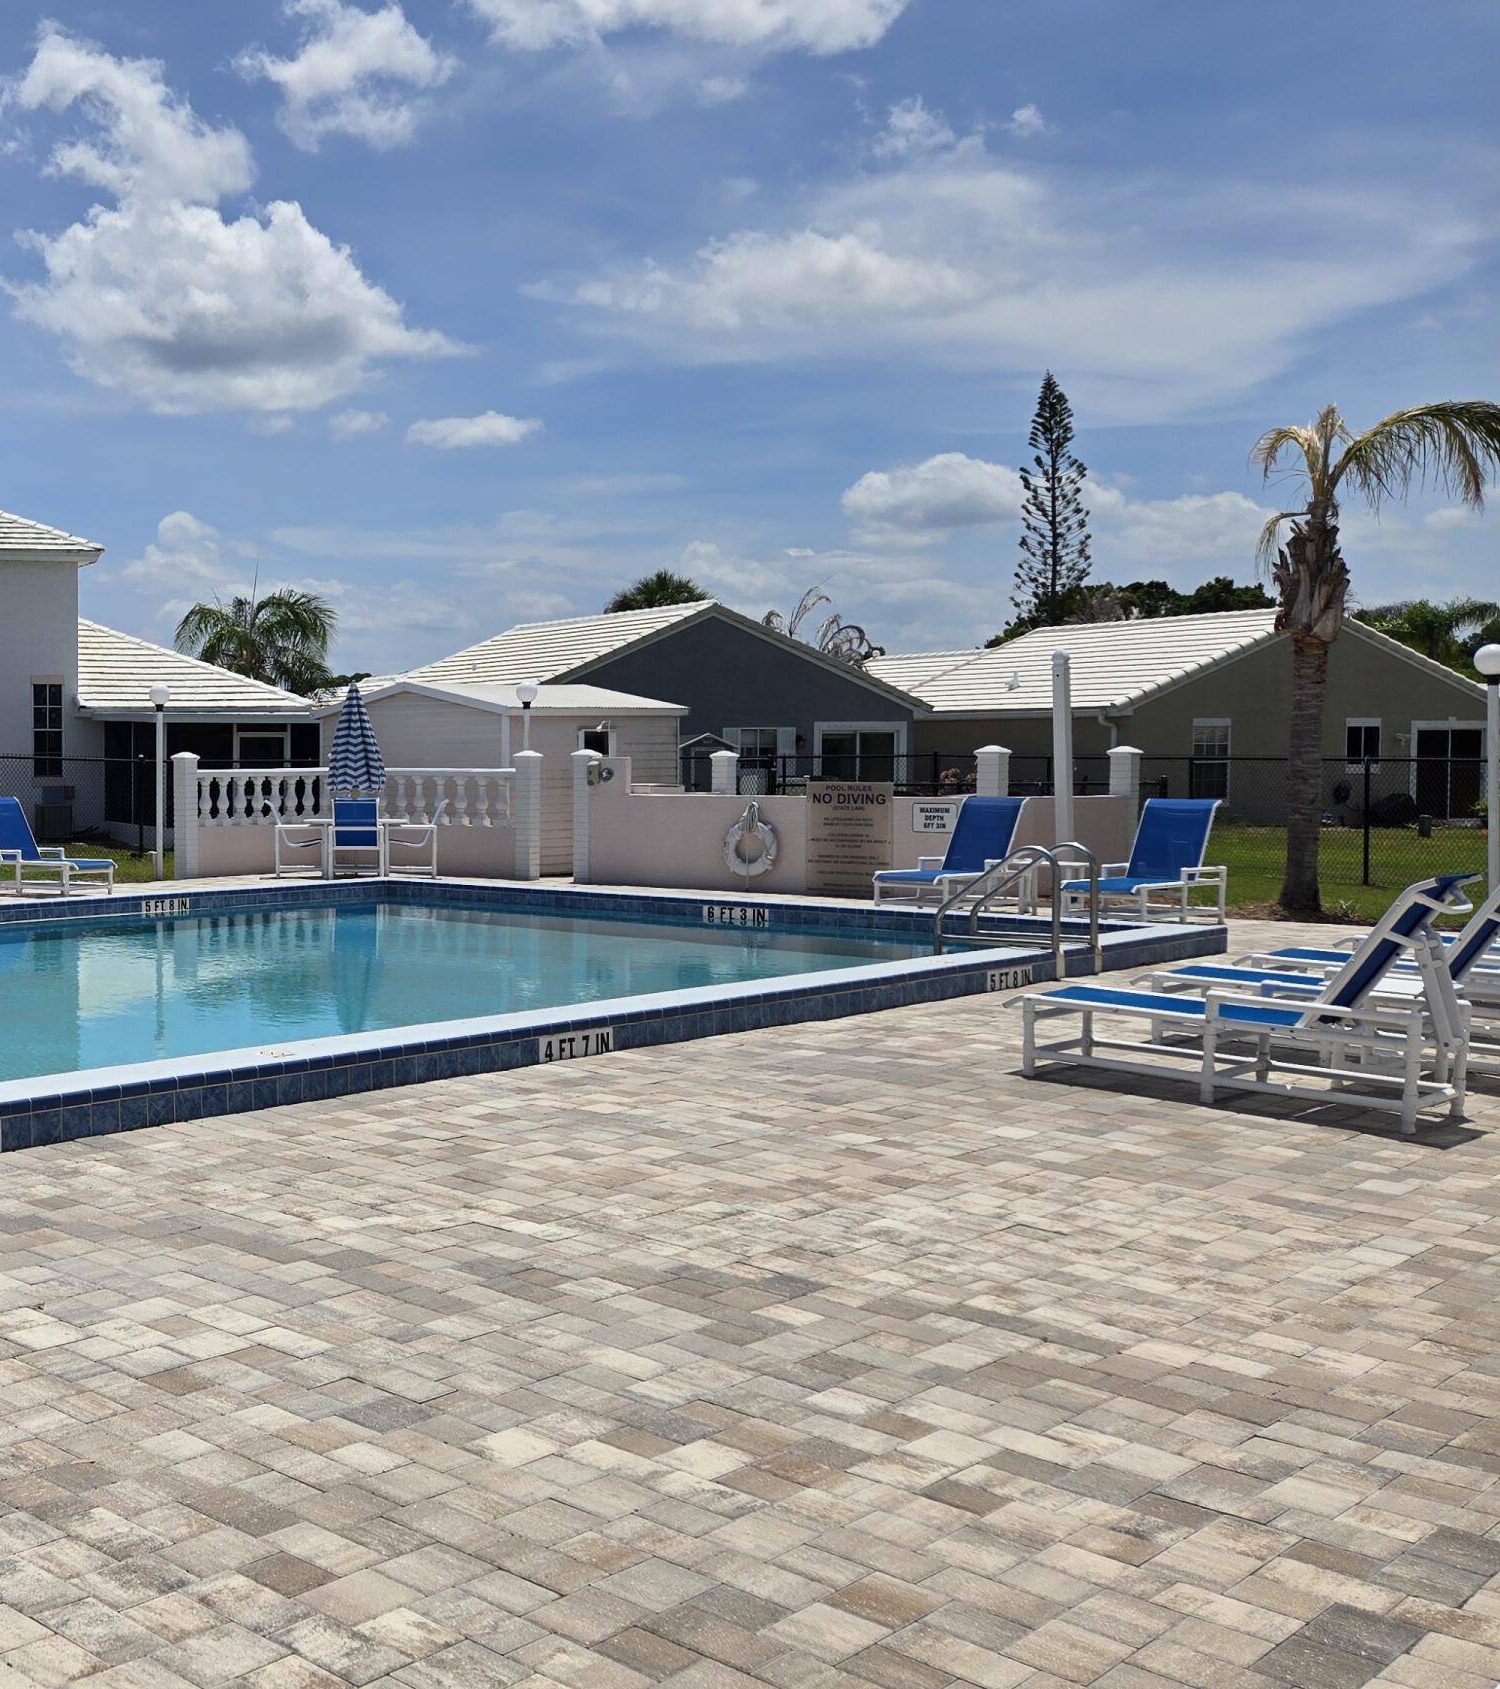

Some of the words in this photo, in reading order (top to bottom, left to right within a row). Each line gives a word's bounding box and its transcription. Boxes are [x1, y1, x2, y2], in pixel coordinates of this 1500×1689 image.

[813, 793, 832, 804] NO
[837, 793, 886, 805] DIVING
[145, 901, 151, 912] 5
[169, 899, 174, 911] 8
[707, 906, 715, 919] 6
[740, 908, 747, 921] 3
[990, 974, 996, 991] 5
[1013, 970, 1018, 988] 8
[545, 1041, 553, 1062] 4
[582, 1035, 590, 1057] 7
